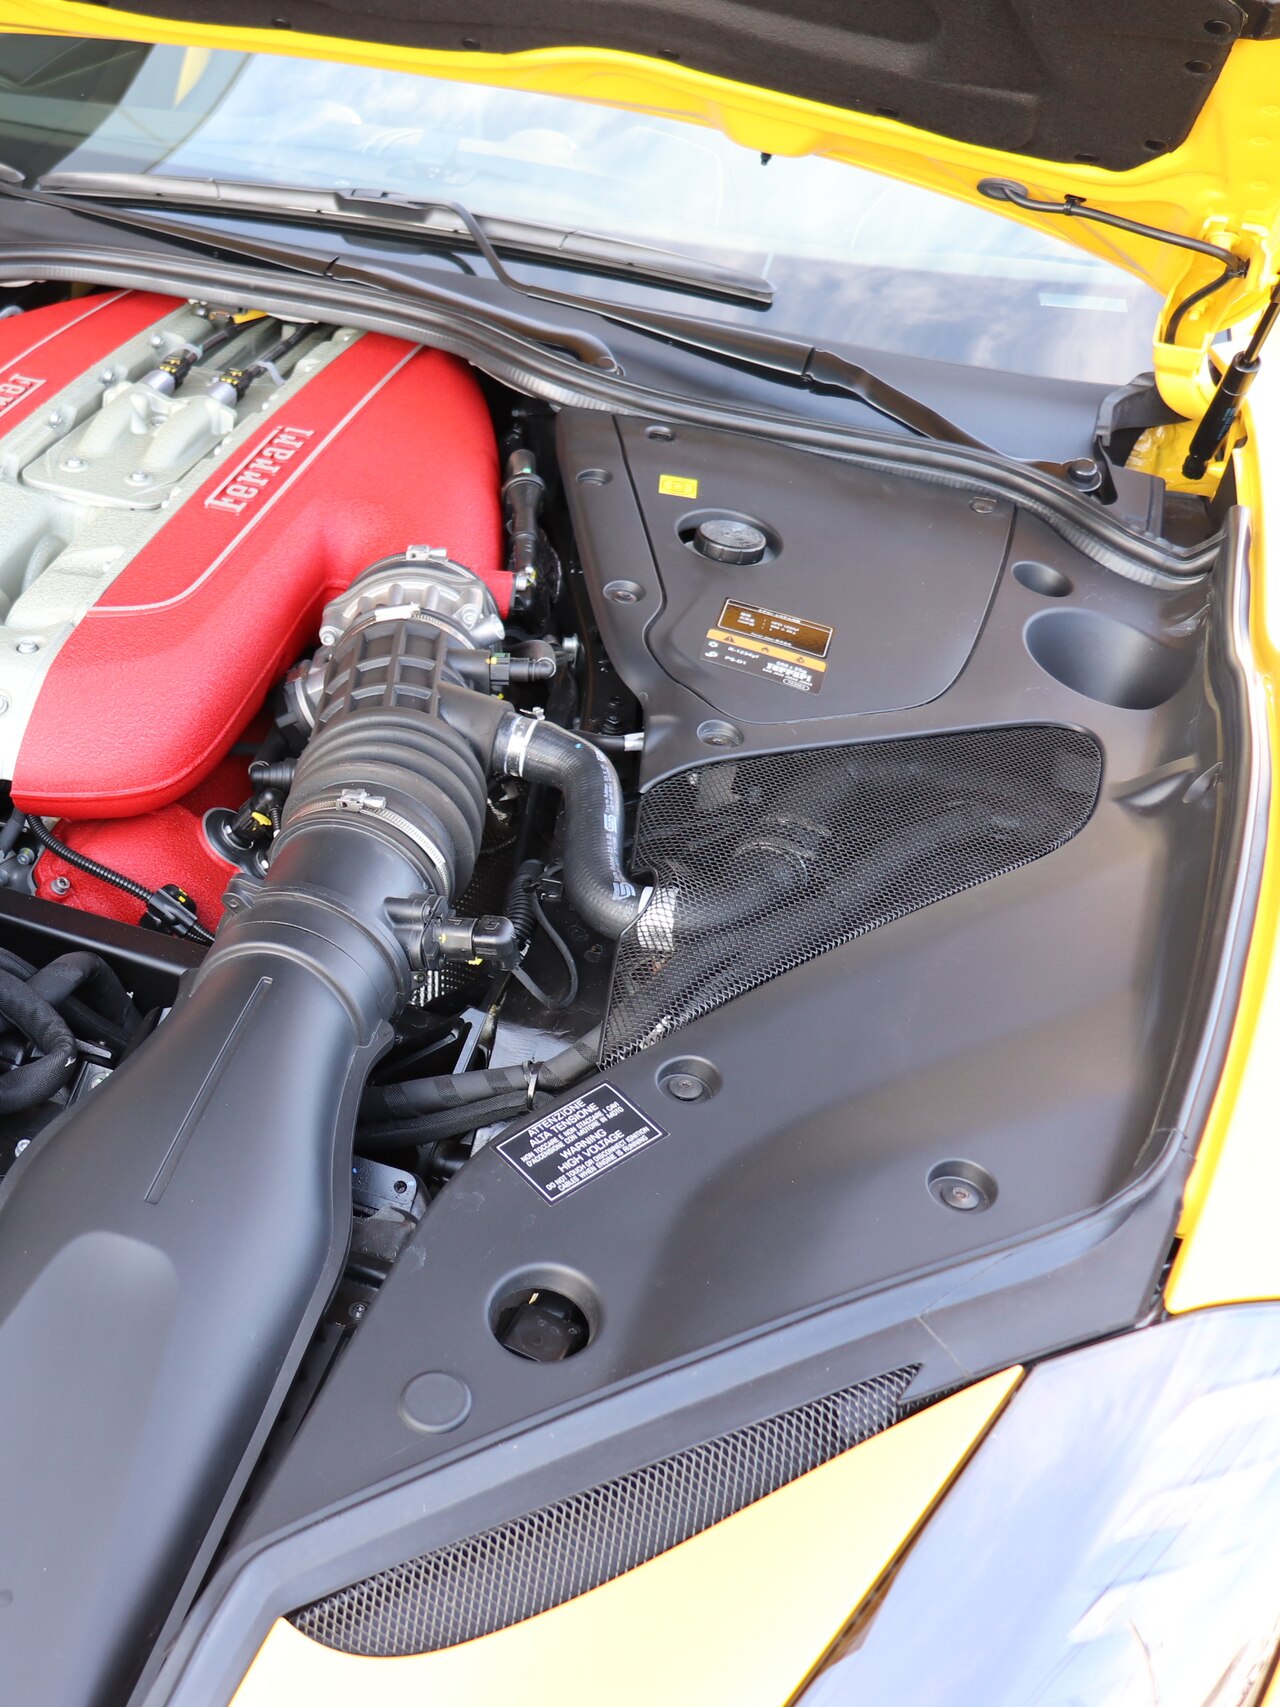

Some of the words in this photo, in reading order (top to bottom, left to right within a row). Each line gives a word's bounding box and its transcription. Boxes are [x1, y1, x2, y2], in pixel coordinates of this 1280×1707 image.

[204, 427, 315, 515] Ferrari
[528, 1100, 586, 1137] ATTENZIONE
[530, 1131, 552, 1147] ALTA
[550, 1103, 599, 1133] TENSIONE
[564, 1134, 578, 1144] CON
[576, 1120, 600, 1136] MOTORE
[606, 1106, 624, 1119] MOTO
[520, 1152, 536, 1162] NON
[534, 1137, 560, 1154] TOCCARE
[563, 1126, 577, 1136] NON
[546, 1182, 556, 1190] DO
[554, 1175, 567, 1186] NOT
[566, 1164, 588, 1179] TOUCH
[584, 1159, 596, 1168] OR
[593, 1139, 626, 1162] DISCONNECT
[625, 1126, 650, 1144] IGNITION
[558, 1154, 584, 1172] HIGH
[582, 1130, 624, 1156] VOLTAGE
[558, 1176, 579, 1191] CABLES
[578, 1166, 597, 1178] WHEN
[596, 1154, 617, 1168] ENGINE
[622, 1135, 648, 1152] RUNNING
[560, 1129, 606, 1158] WARNING
